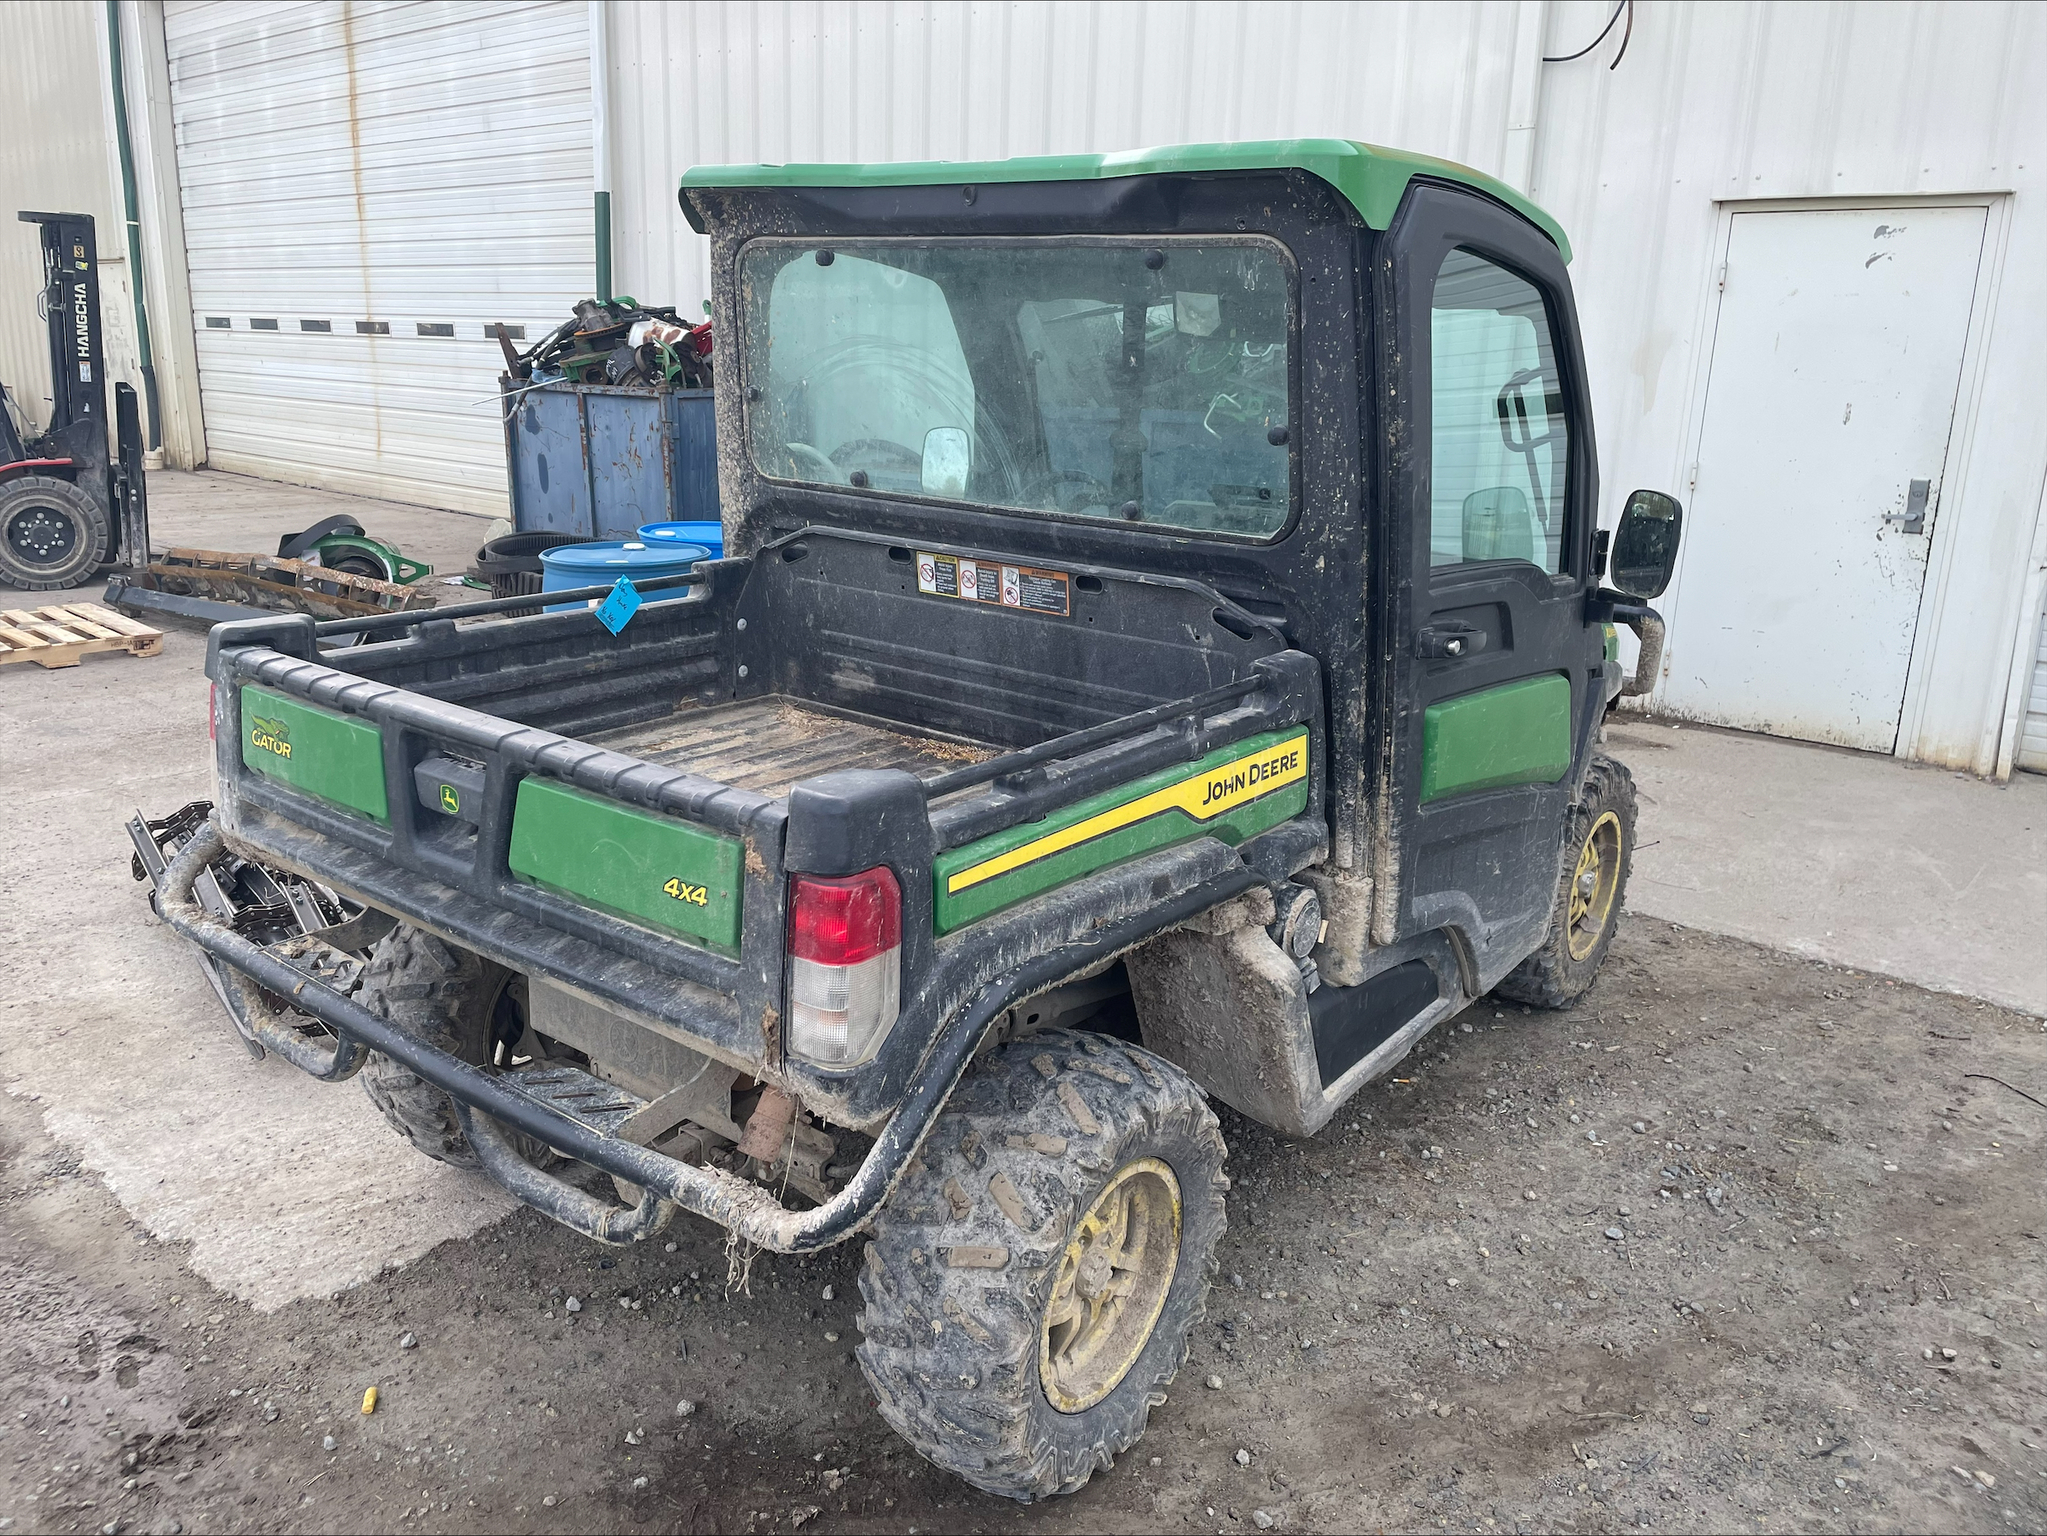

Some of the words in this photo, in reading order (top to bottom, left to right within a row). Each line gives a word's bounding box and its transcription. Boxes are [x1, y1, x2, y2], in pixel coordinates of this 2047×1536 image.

[74, 283, 90, 358] HANGCHA
[251, 729, 292, 759] GATOR
[1203, 772, 1245, 806] JOHN
[1249, 751, 1298, 786] DEERE
